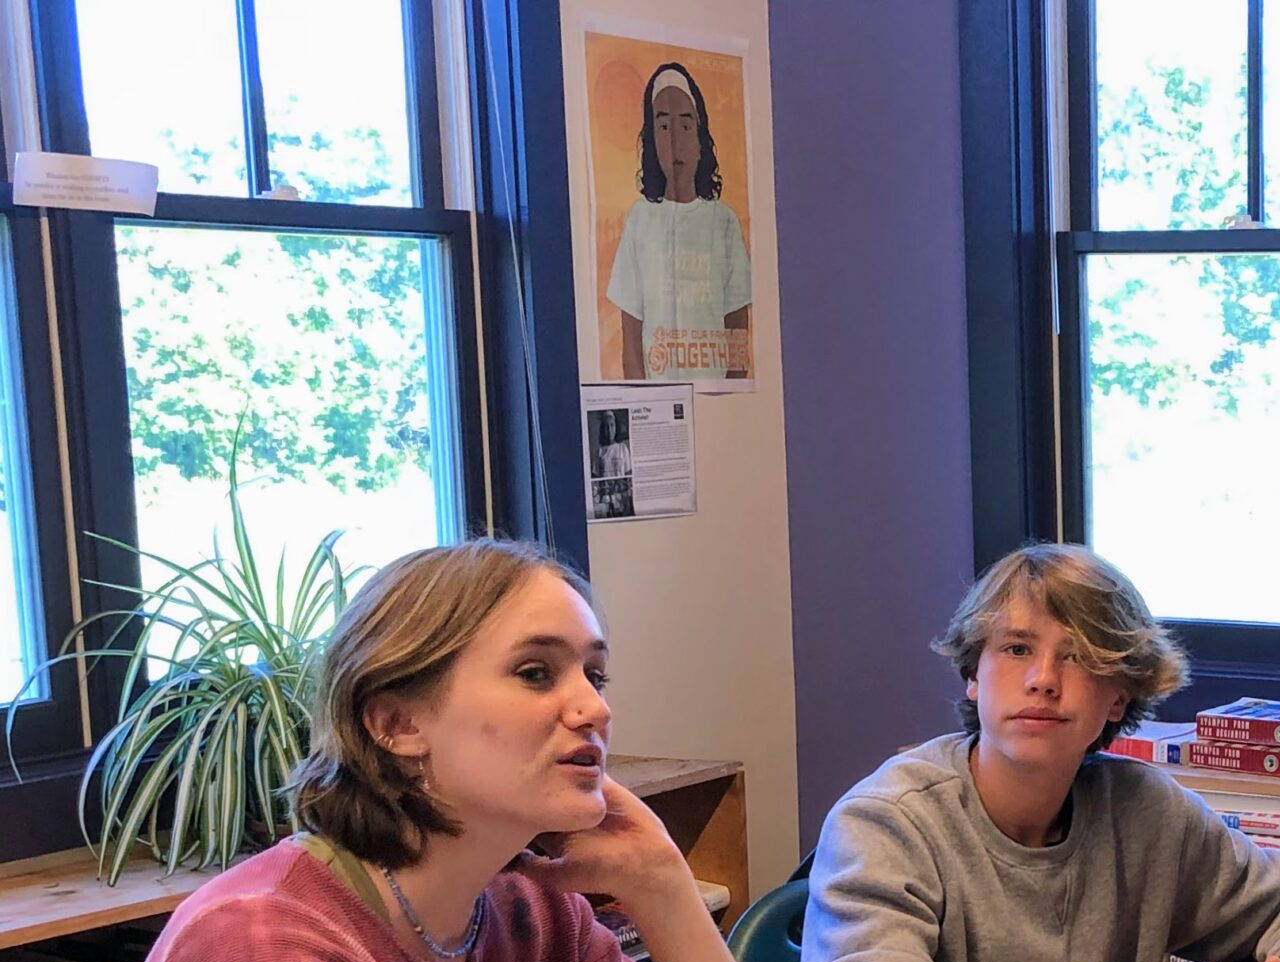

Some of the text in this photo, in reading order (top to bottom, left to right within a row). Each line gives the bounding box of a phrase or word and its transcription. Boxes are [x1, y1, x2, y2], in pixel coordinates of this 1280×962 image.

[665, 329, 688, 340] KEEP
[667, 342, 750, 369] TOGETHER
[1200, 716, 1250, 730] STAMPED FROM
[1200, 725, 1250, 740] THE BEGINNING
[1192, 744, 1240, 758] STAMPED FROM
[1192, 755, 1240, 768] THE BEGINNING
